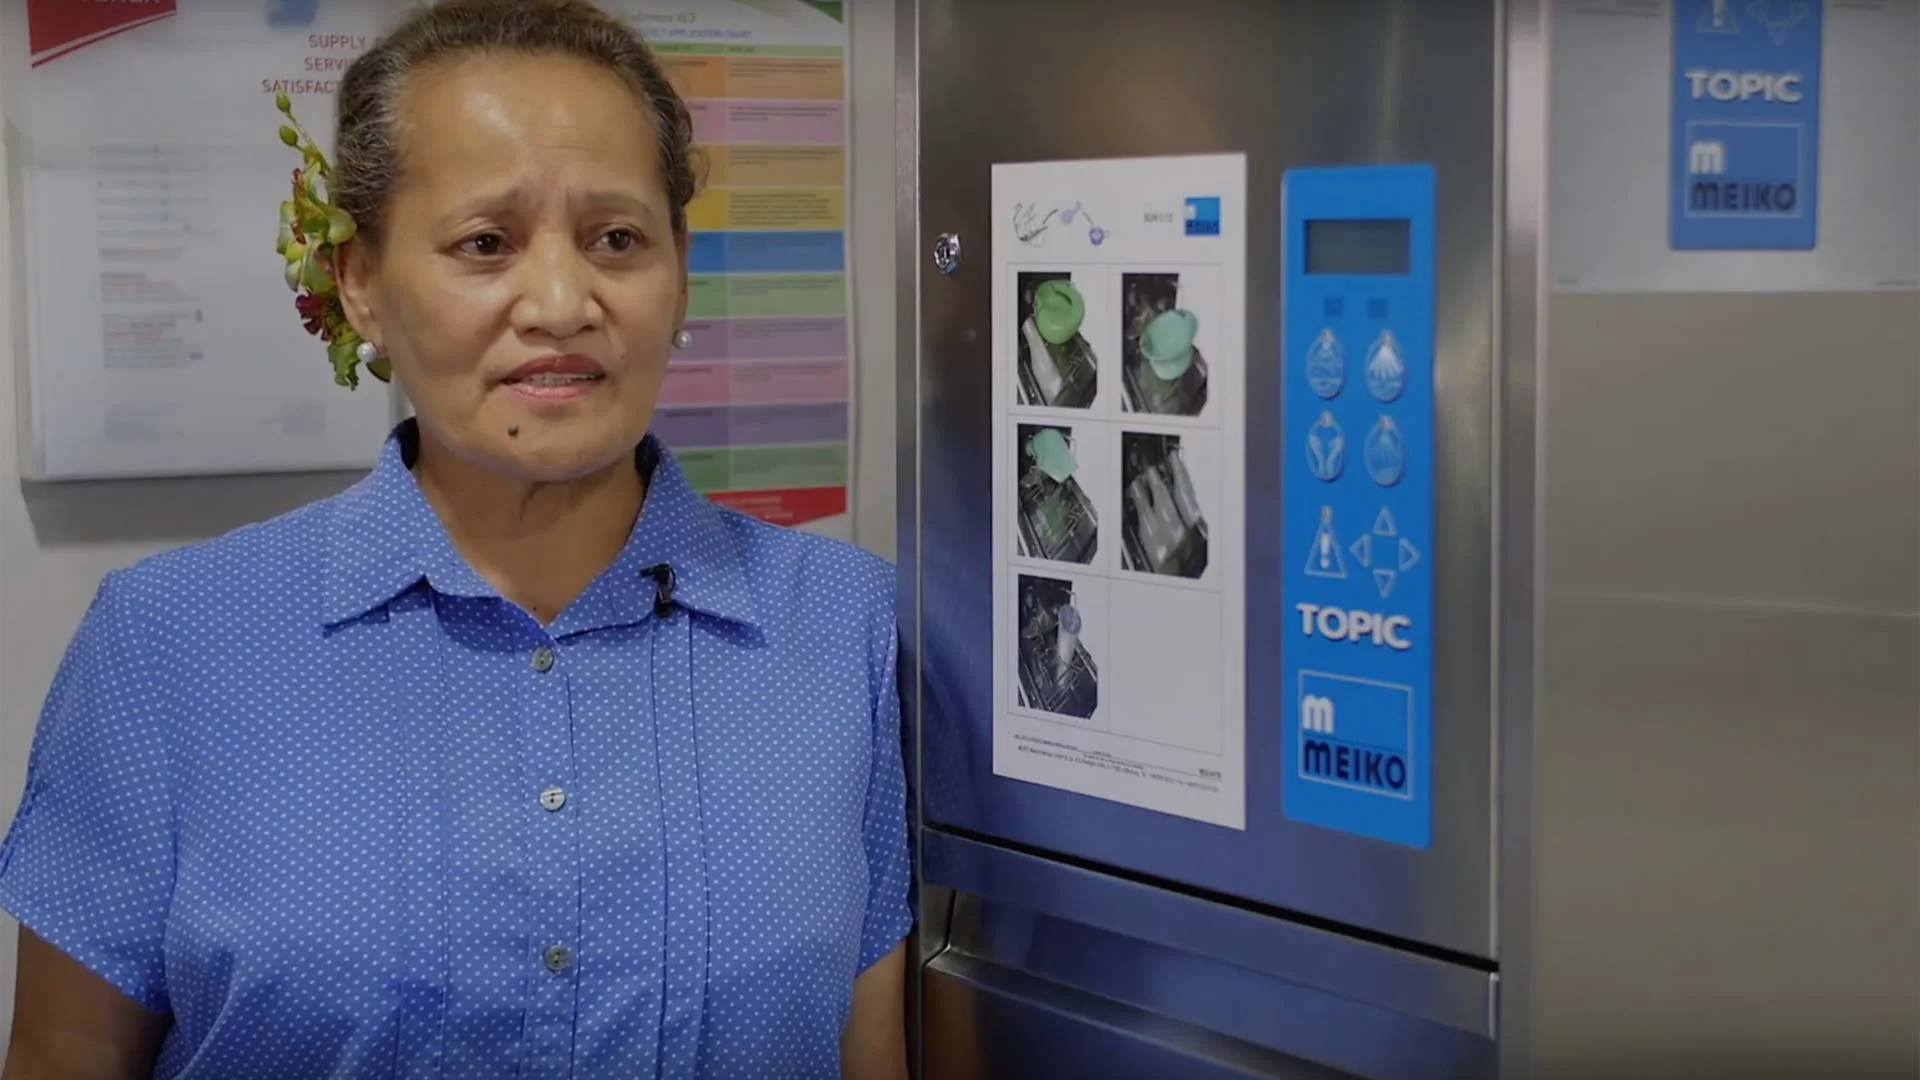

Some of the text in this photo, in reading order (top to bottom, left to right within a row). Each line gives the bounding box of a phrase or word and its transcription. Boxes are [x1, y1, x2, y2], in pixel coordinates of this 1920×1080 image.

[308, 33, 366, 49] SUPPLY
[1685, 71, 1804, 103] TOPIC
[1690, 181, 1797, 212] MEIKO
[1296, 603, 1411, 650] TOPIC
[1304, 739, 1406, 790] MEIKO
